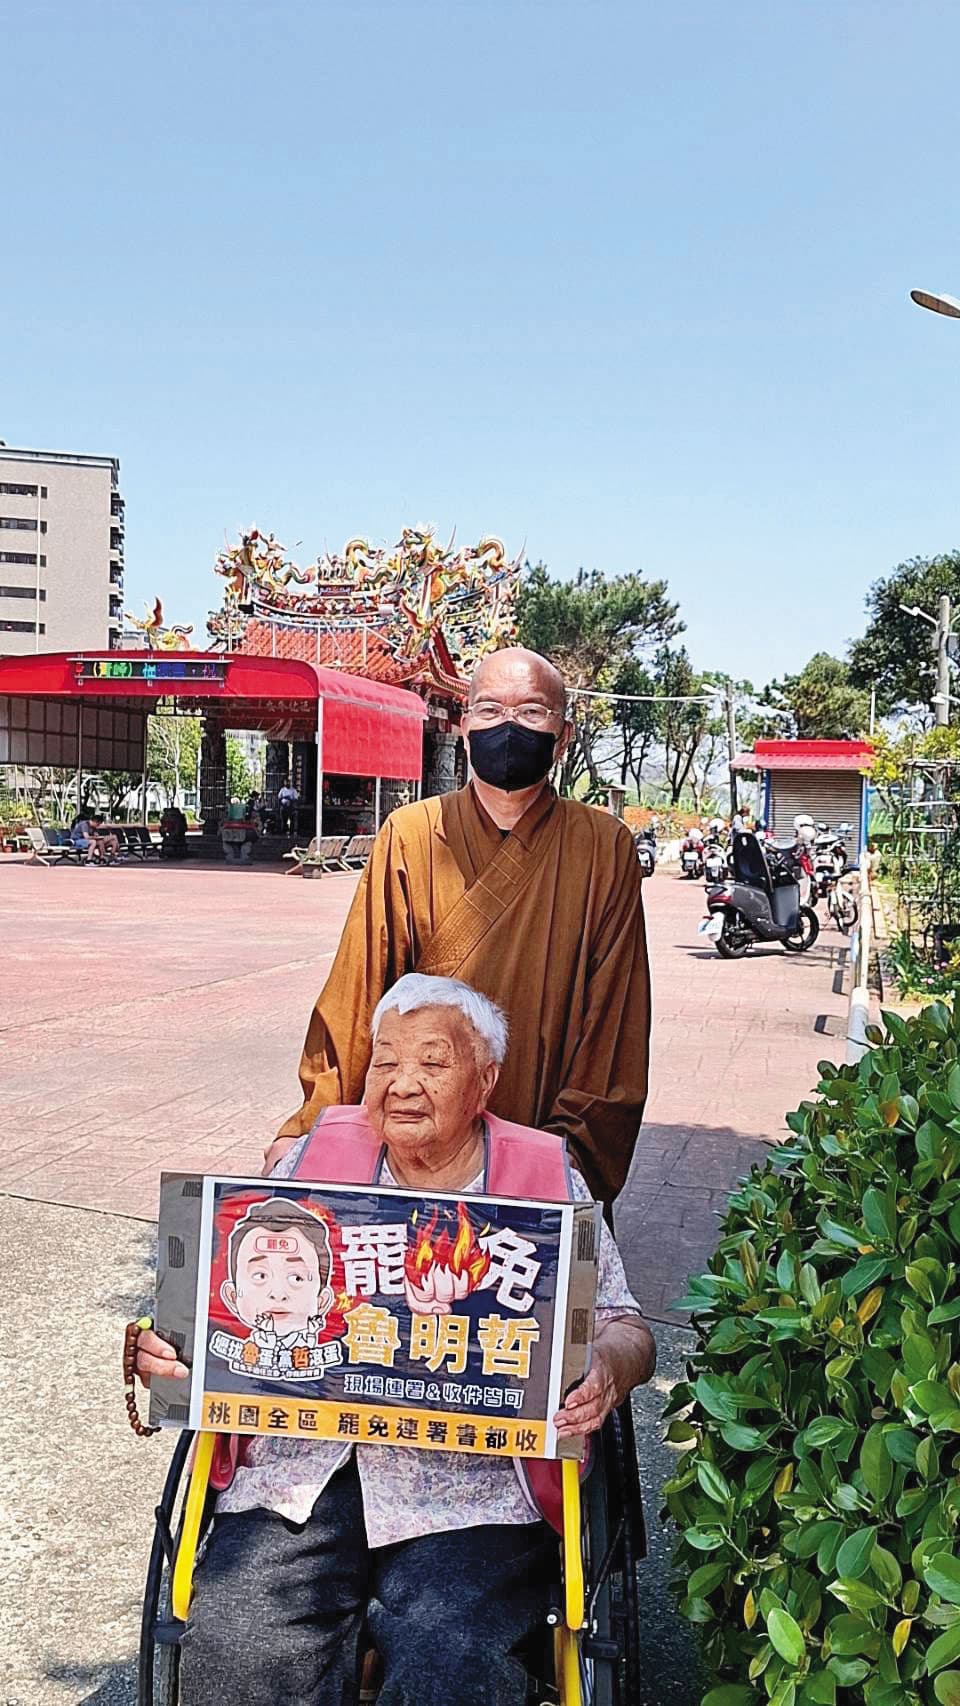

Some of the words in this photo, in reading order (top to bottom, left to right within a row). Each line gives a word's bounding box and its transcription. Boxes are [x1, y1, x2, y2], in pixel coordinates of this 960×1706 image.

[340, 1223, 542, 1312] 罷免
[342, 1303, 540, 1379] 魯明哲
[344, 1374, 524, 1409] 現場連署&收件皆可
[208, 1401, 319, 1431] 桃園全區
[337, 1412, 538, 1452] 罷免連署書都收
